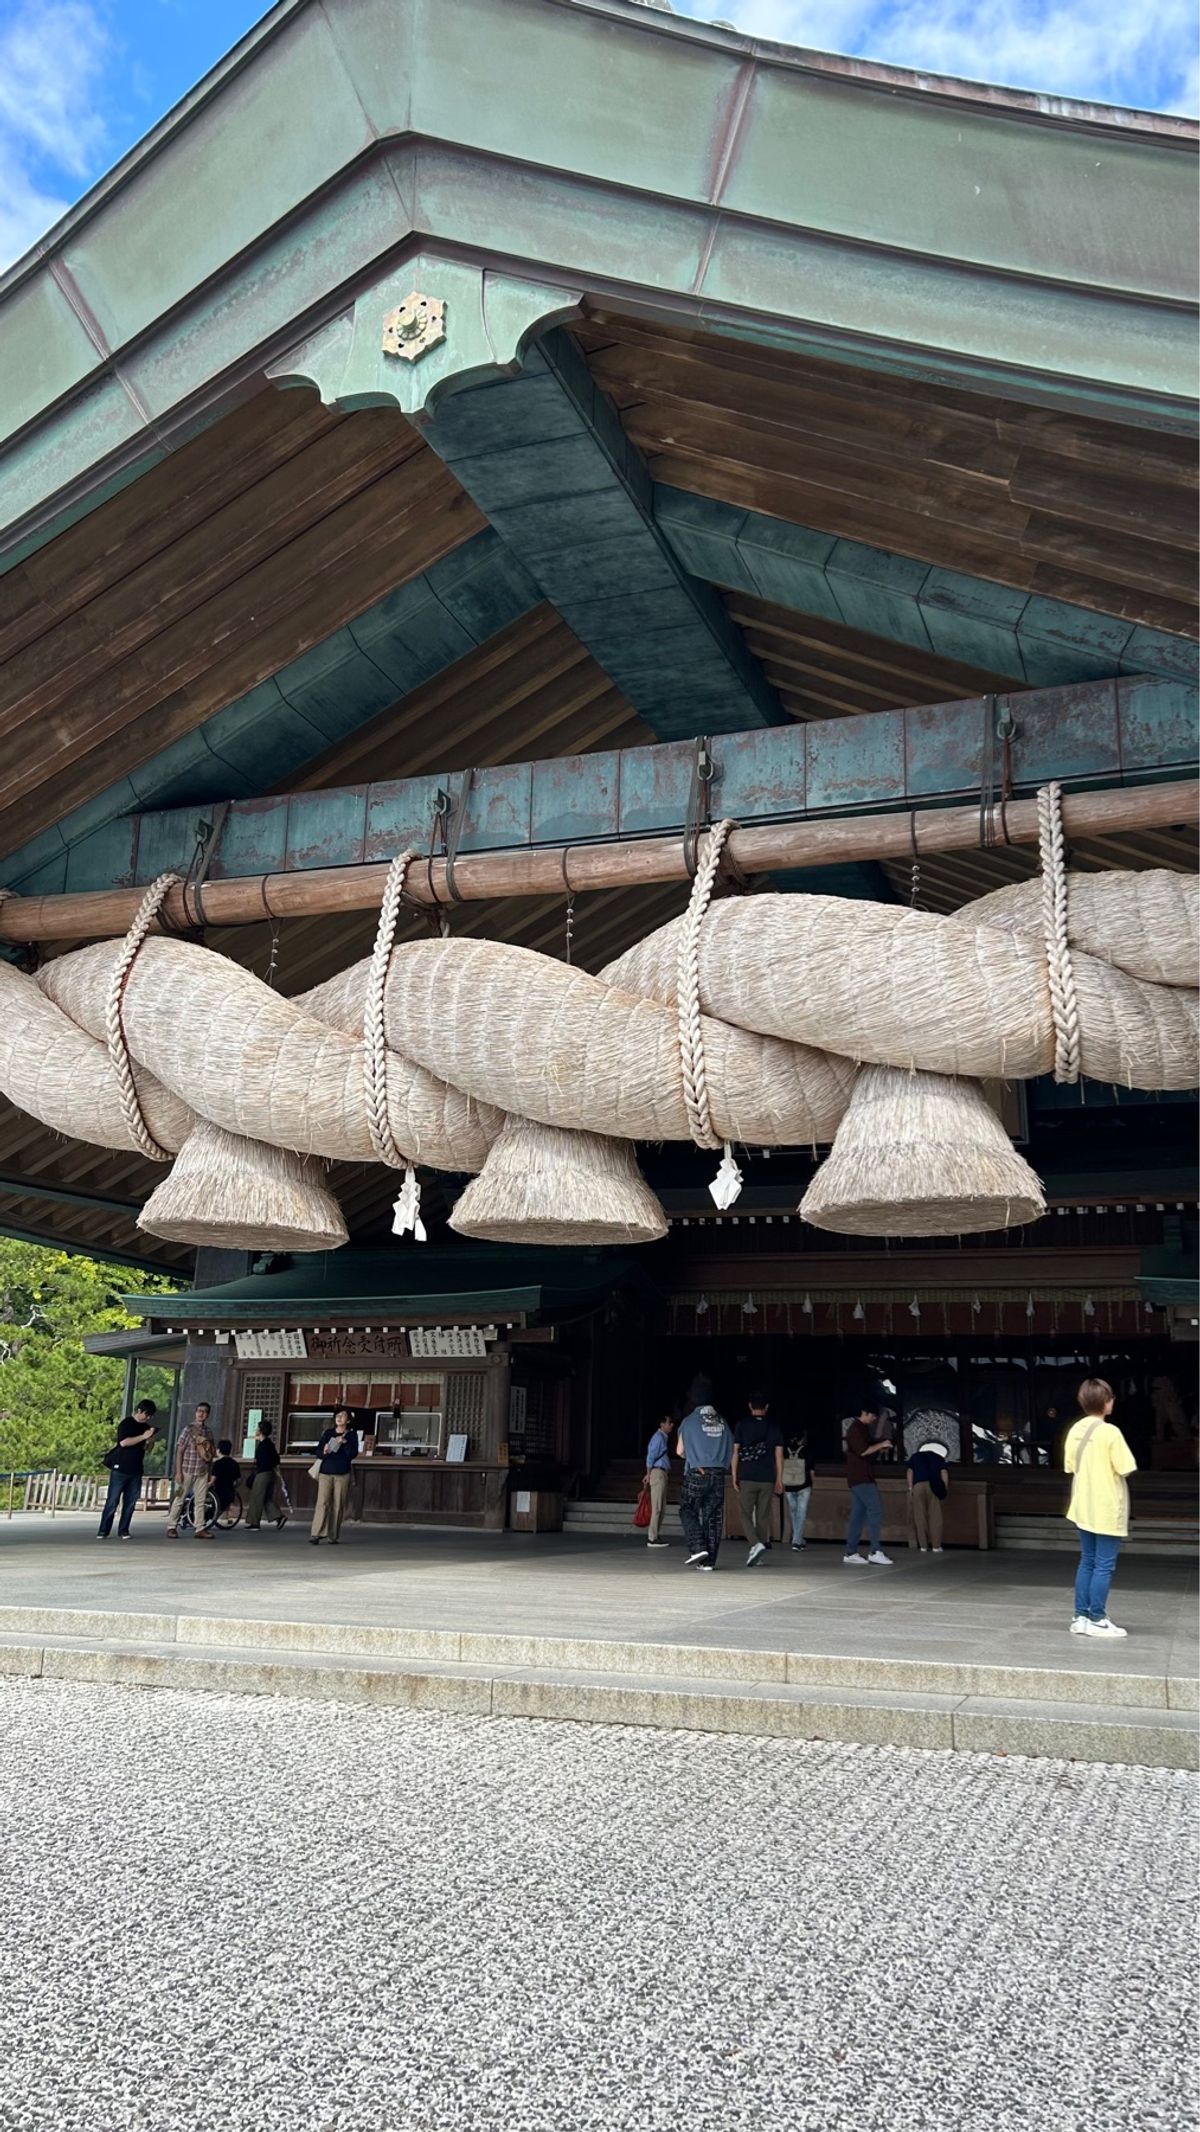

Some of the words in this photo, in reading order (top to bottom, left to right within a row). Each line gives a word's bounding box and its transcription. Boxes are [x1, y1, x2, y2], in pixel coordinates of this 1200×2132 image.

[311, 1335, 402, 1355] 御祈念受付所
